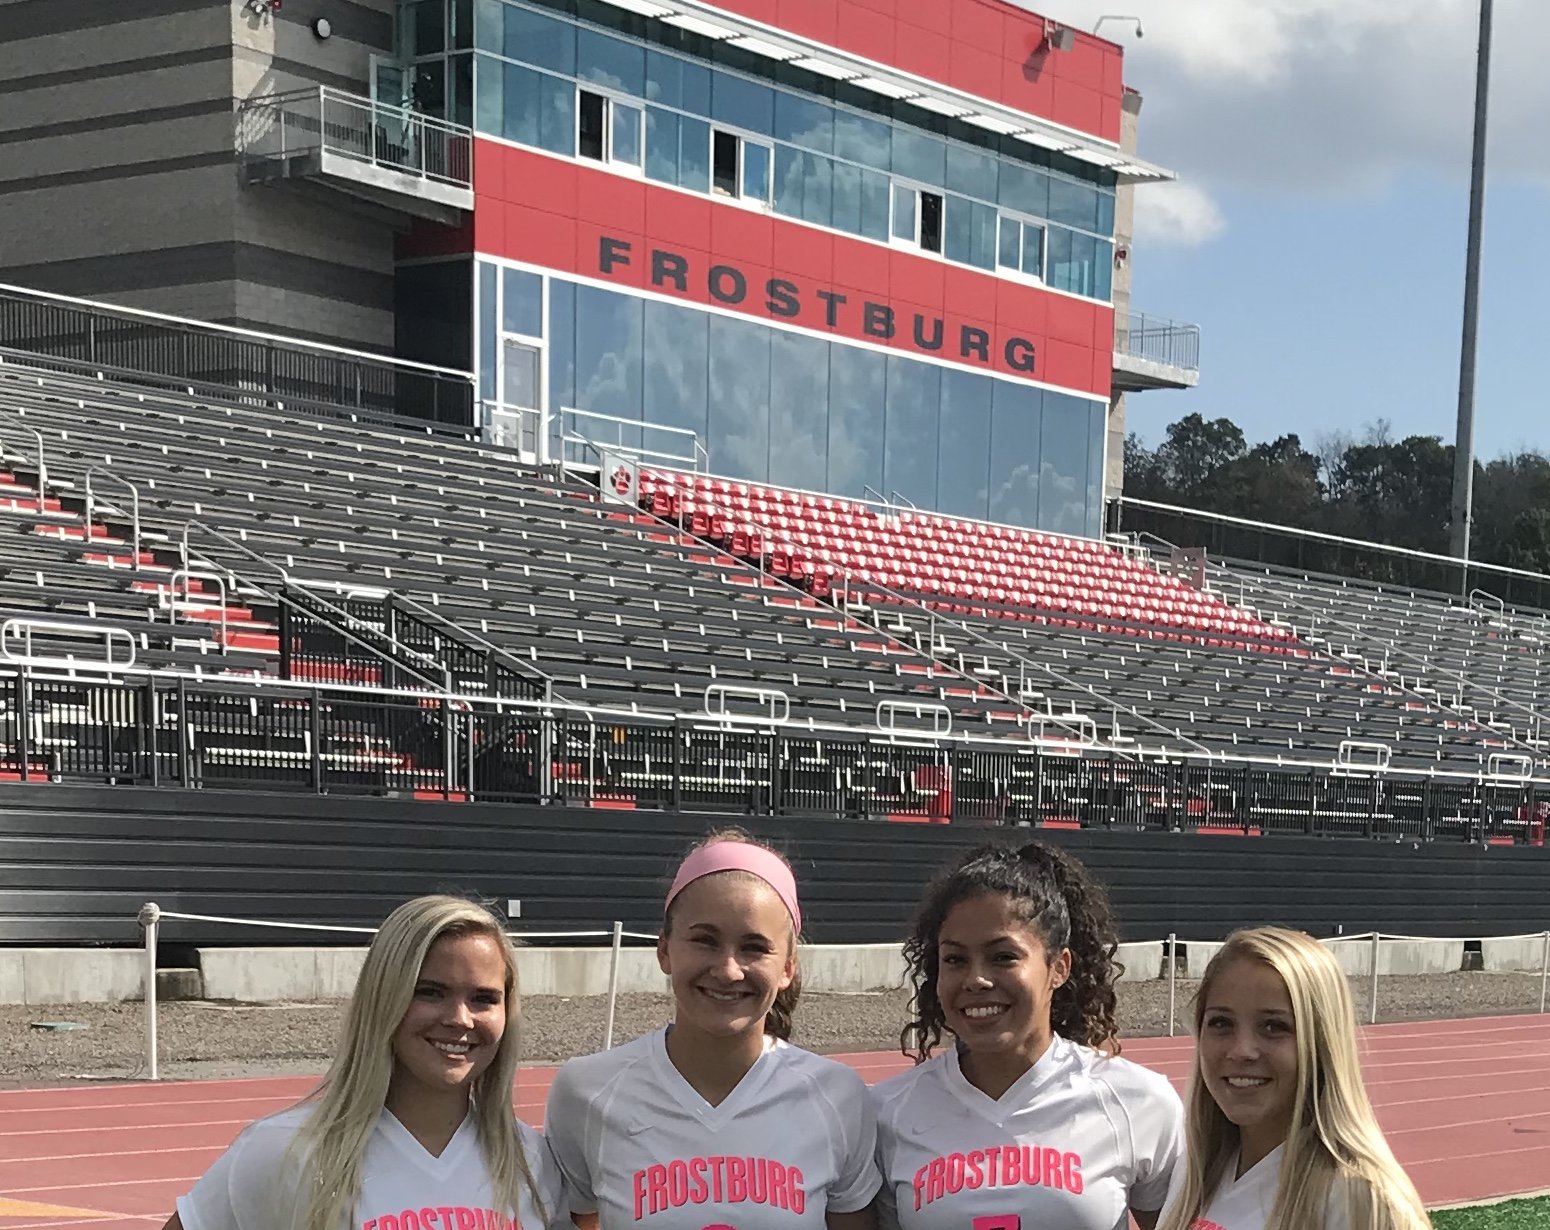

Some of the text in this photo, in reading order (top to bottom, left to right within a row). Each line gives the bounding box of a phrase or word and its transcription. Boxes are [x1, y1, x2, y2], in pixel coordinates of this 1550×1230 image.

[600, 237, 1036, 373] FROSTBURG
[632, 1156, 806, 1221] FROSTBURG
[912, 1146, 1084, 1212] FROSTBURG
